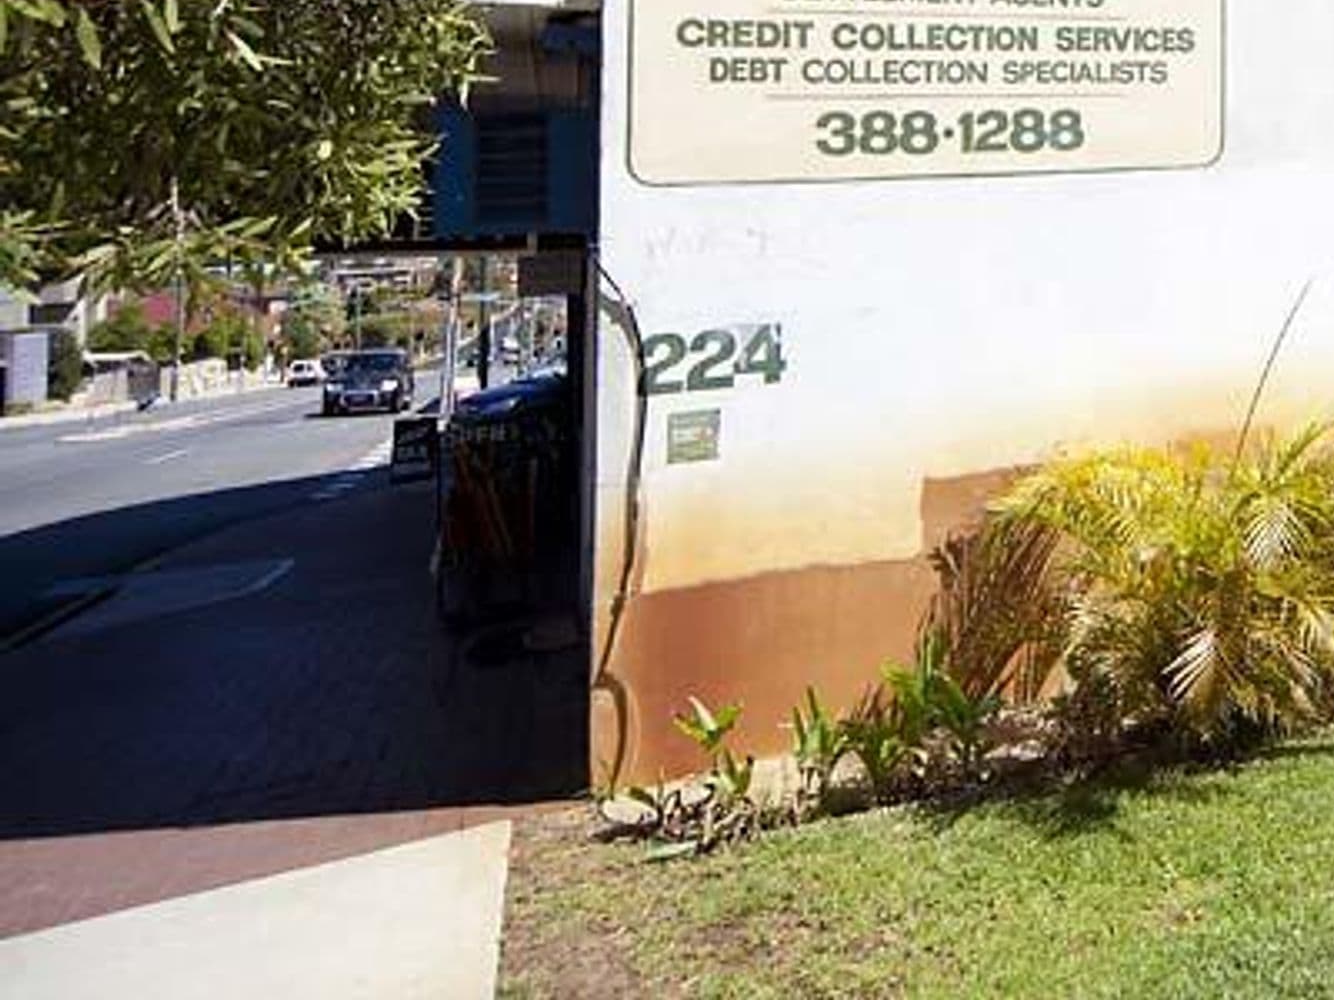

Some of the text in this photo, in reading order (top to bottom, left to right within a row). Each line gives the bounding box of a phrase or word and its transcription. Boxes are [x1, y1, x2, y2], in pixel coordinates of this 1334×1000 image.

[676, 19, 1196, 54] CREDIT COLLECTION SERVICES
[709, 58, 1168, 85] DEBT COLLECTION SPECIALISTS
[641, 322, 787, 394] 224
